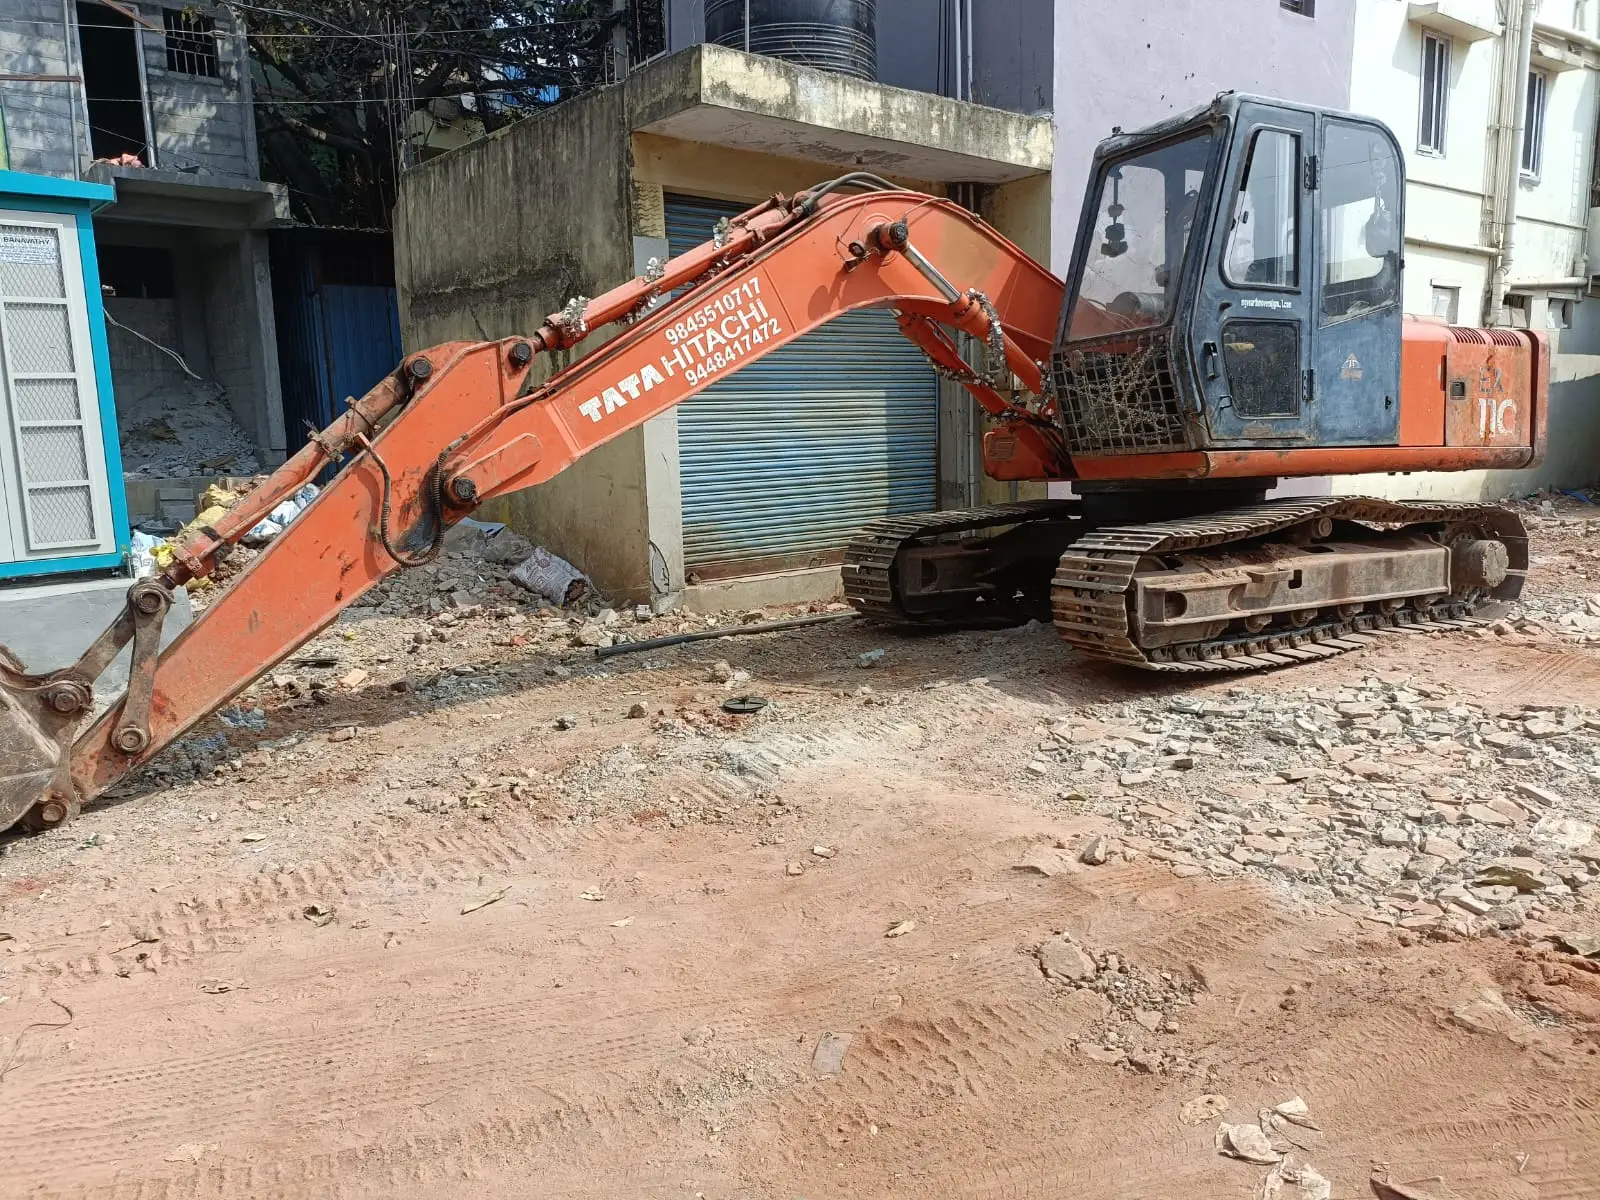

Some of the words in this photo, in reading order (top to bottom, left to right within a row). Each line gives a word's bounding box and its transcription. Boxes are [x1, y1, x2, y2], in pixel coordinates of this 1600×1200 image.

[665, 276, 761, 345] 9845510717
[578, 364, 664, 423] TATA
[660, 298, 769, 377] HITACHI
[684, 318, 782, 386] 9448417472
